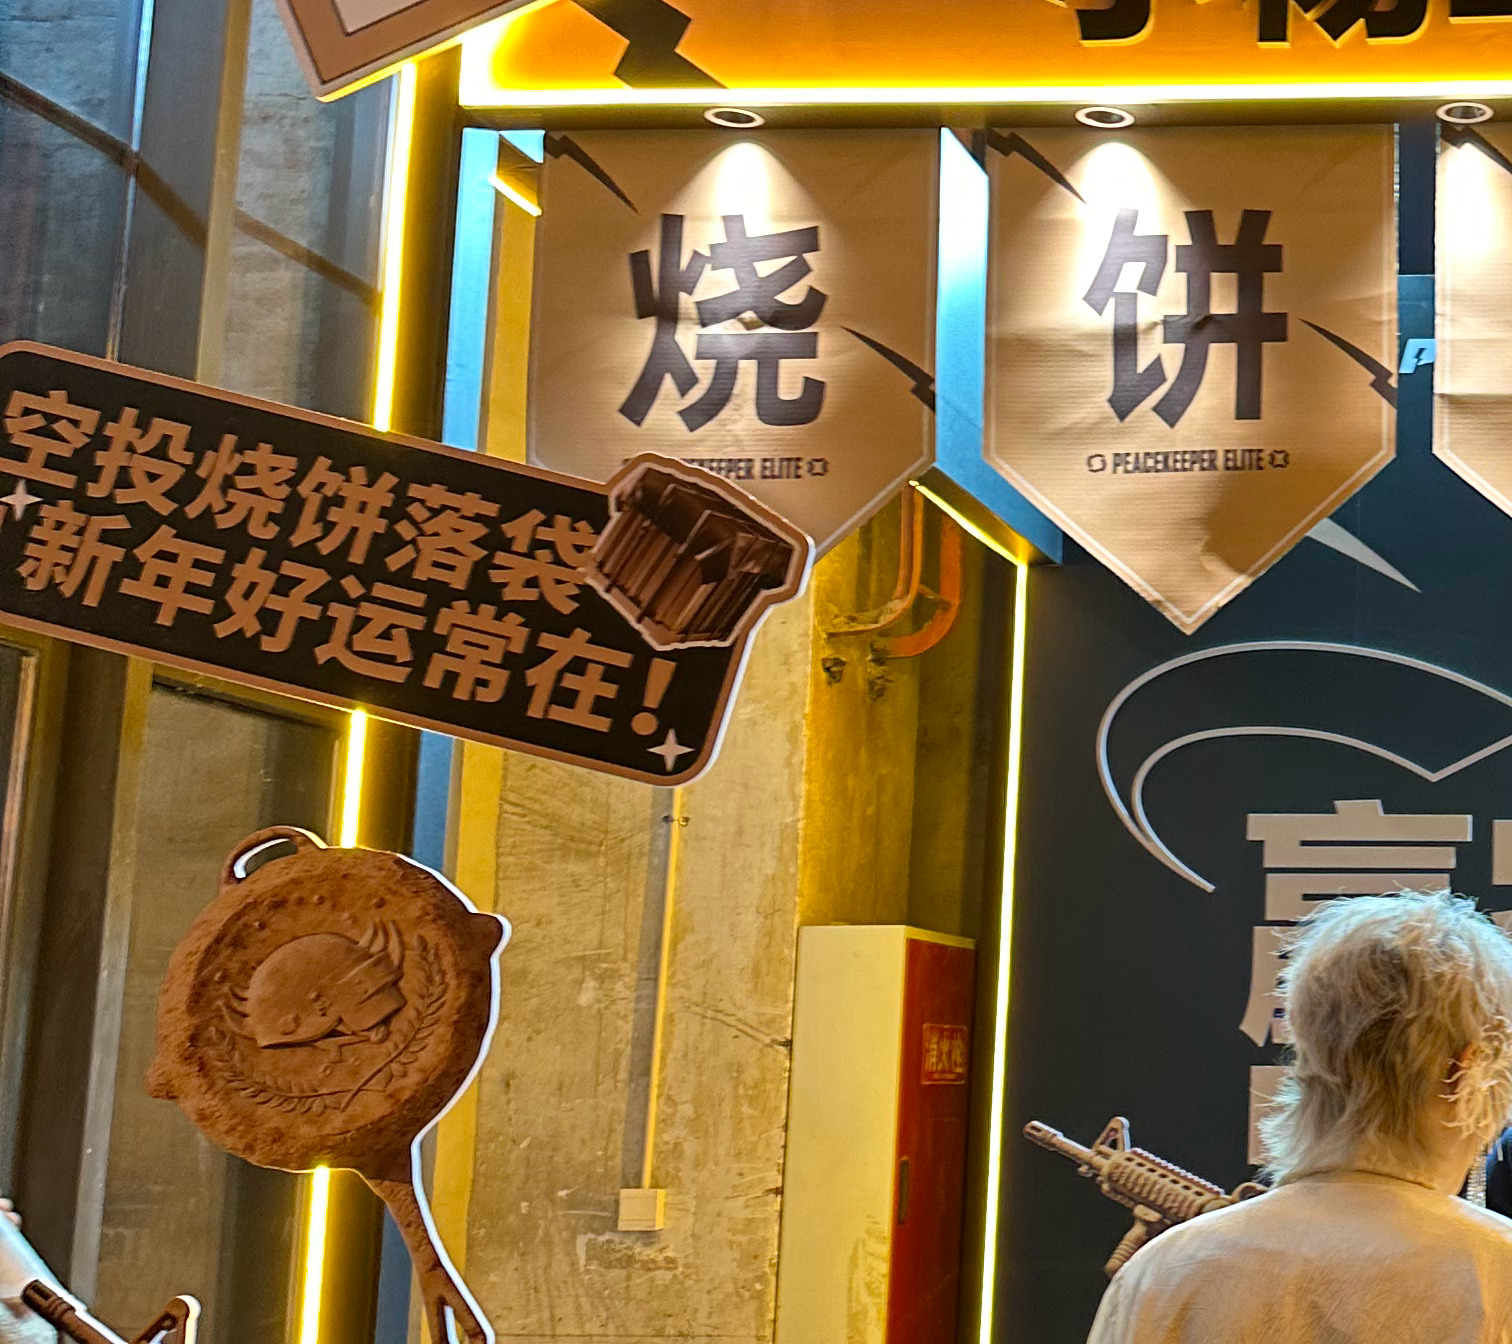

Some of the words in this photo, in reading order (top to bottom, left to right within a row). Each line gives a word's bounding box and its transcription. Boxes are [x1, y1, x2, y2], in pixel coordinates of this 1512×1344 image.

[618, 212, 829, 433] 烧
[1081, 206, 1289, 429] 饼
[0, 389, 600, 615] 空投烧饼落袋
[760, 457, 803, 480] ELITE
[1112, 450, 1218, 474] PEACEKEEPER
[1223, 448, 1264, 471] ELITE
[17, 502, 677, 737] 新年好运常在!
